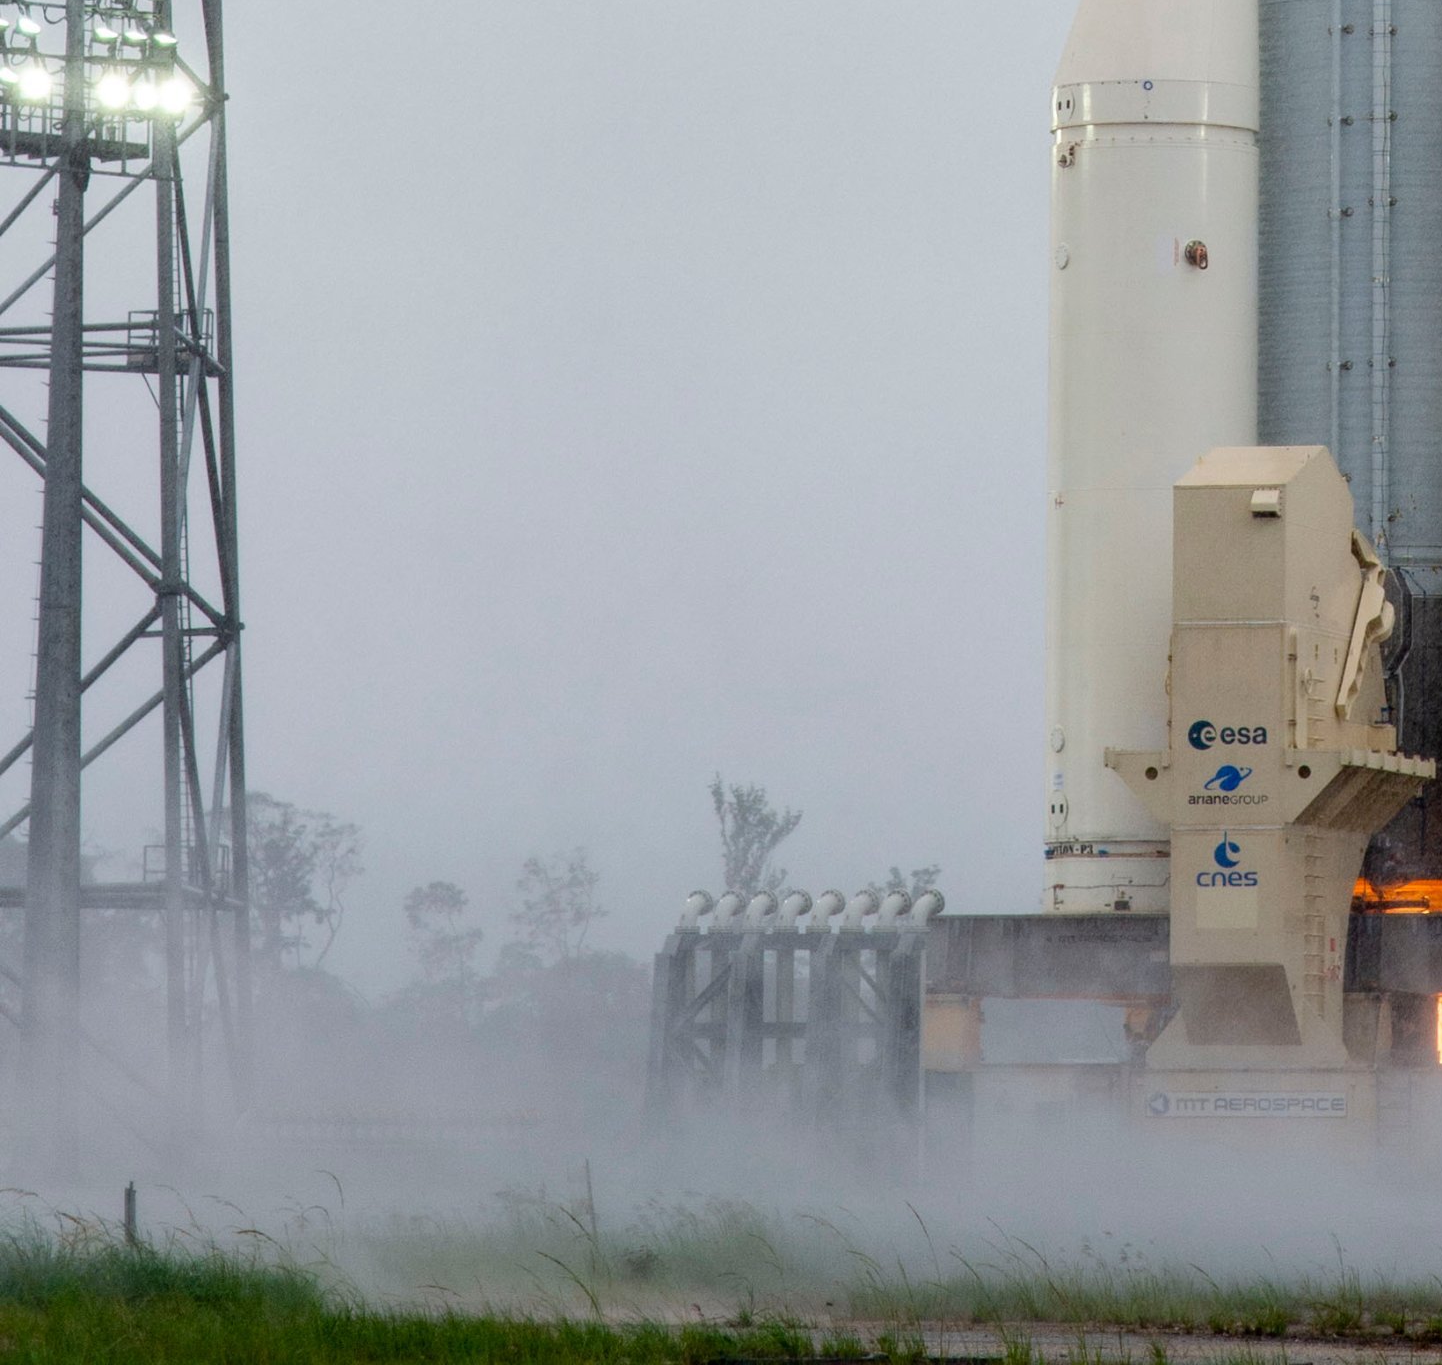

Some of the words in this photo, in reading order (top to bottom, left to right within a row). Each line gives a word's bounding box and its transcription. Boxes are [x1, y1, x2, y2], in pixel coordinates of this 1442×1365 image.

[1219, 725, 1268, 746] esa
[1195, 871, 1259, 888] cnes
[1175, 1097, 1211, 1112] MT
[1213, 1097, 1346, 1112] AEROSPACE
